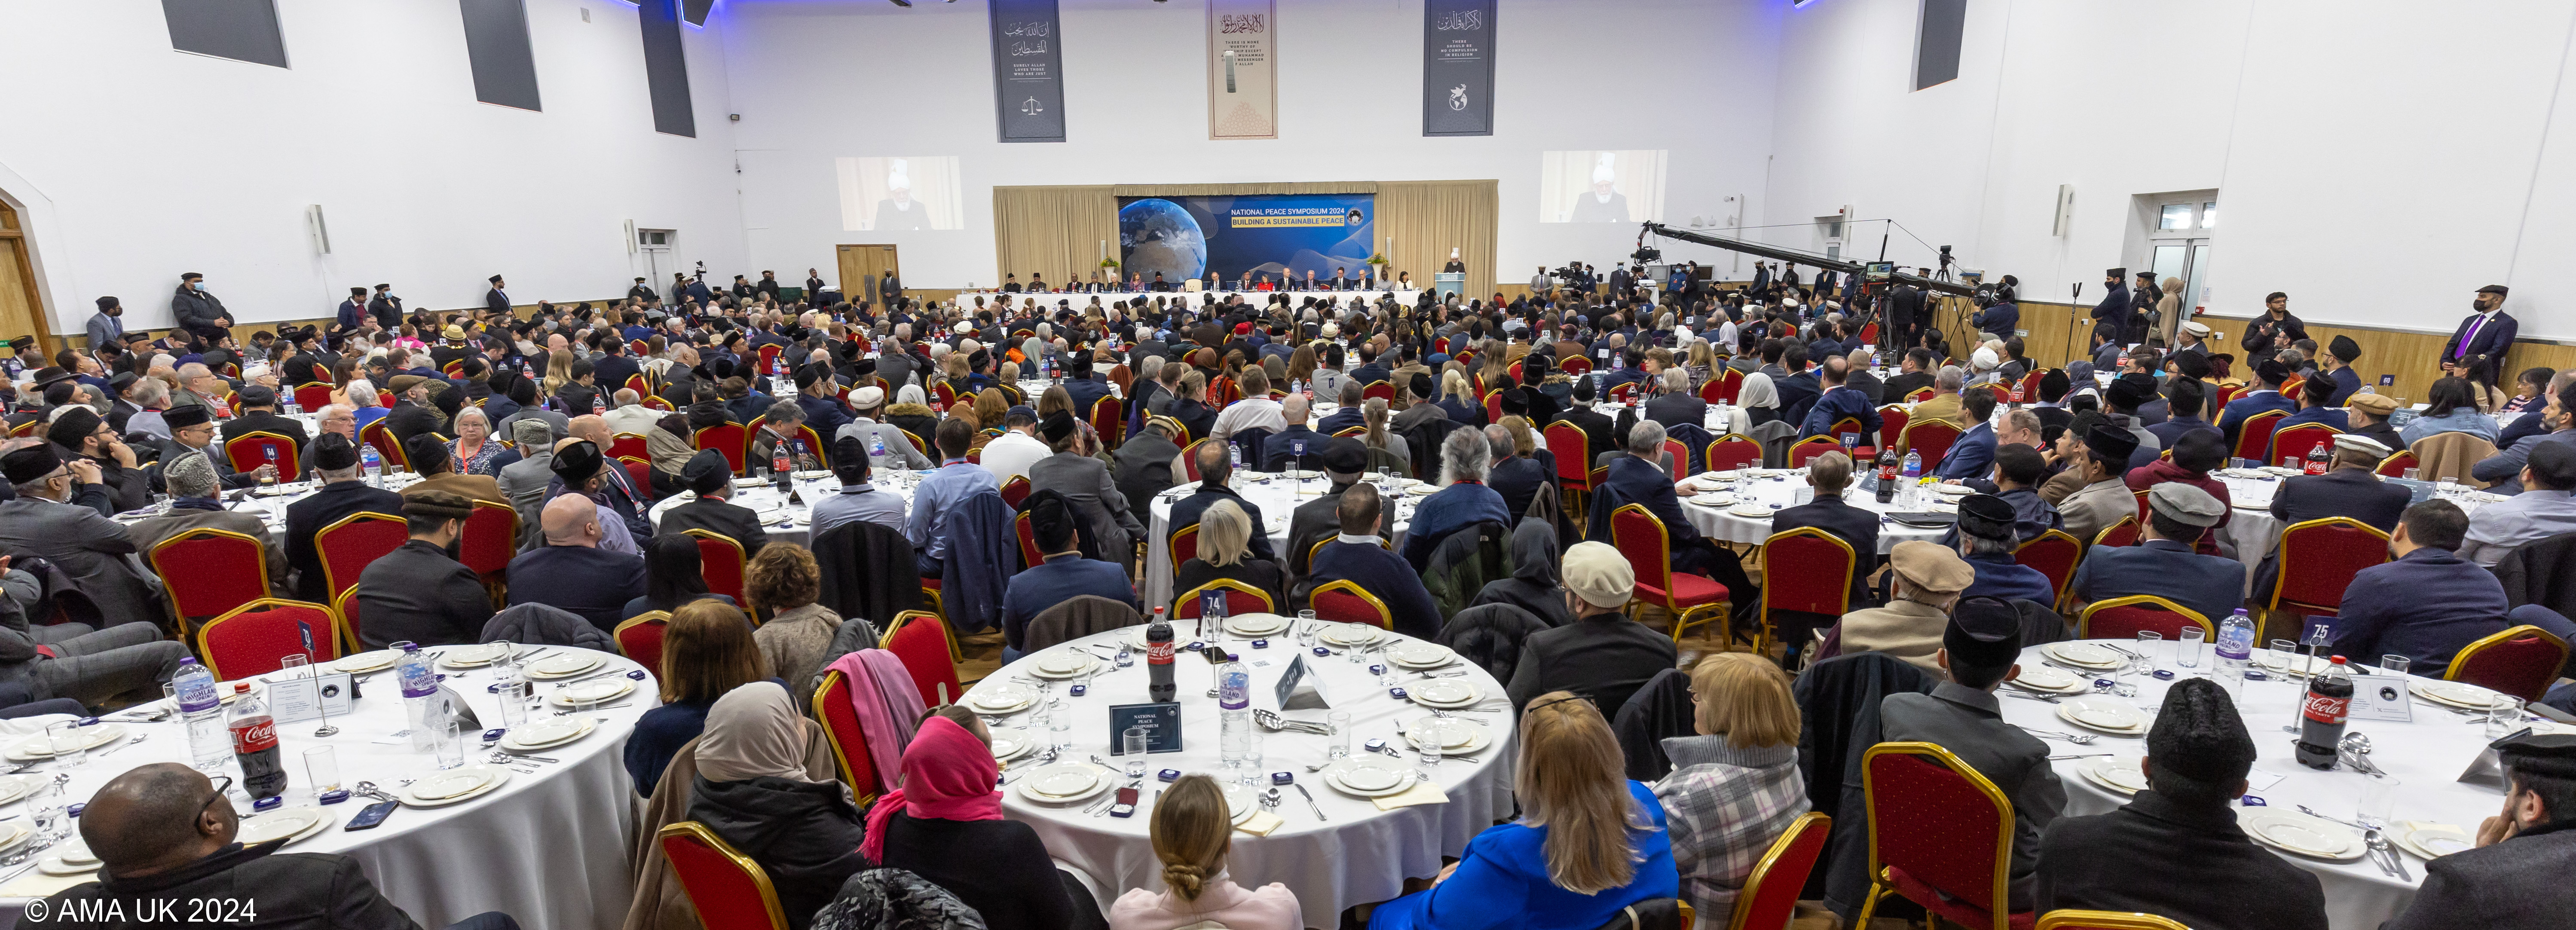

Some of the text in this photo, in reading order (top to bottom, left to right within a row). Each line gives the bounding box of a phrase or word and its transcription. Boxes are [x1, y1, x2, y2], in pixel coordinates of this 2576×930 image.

[1208, 597, 1221, 610] 74
[2315, 624, 2329, 639] 75
[185, 688, 217, 701] HIGHLAND
